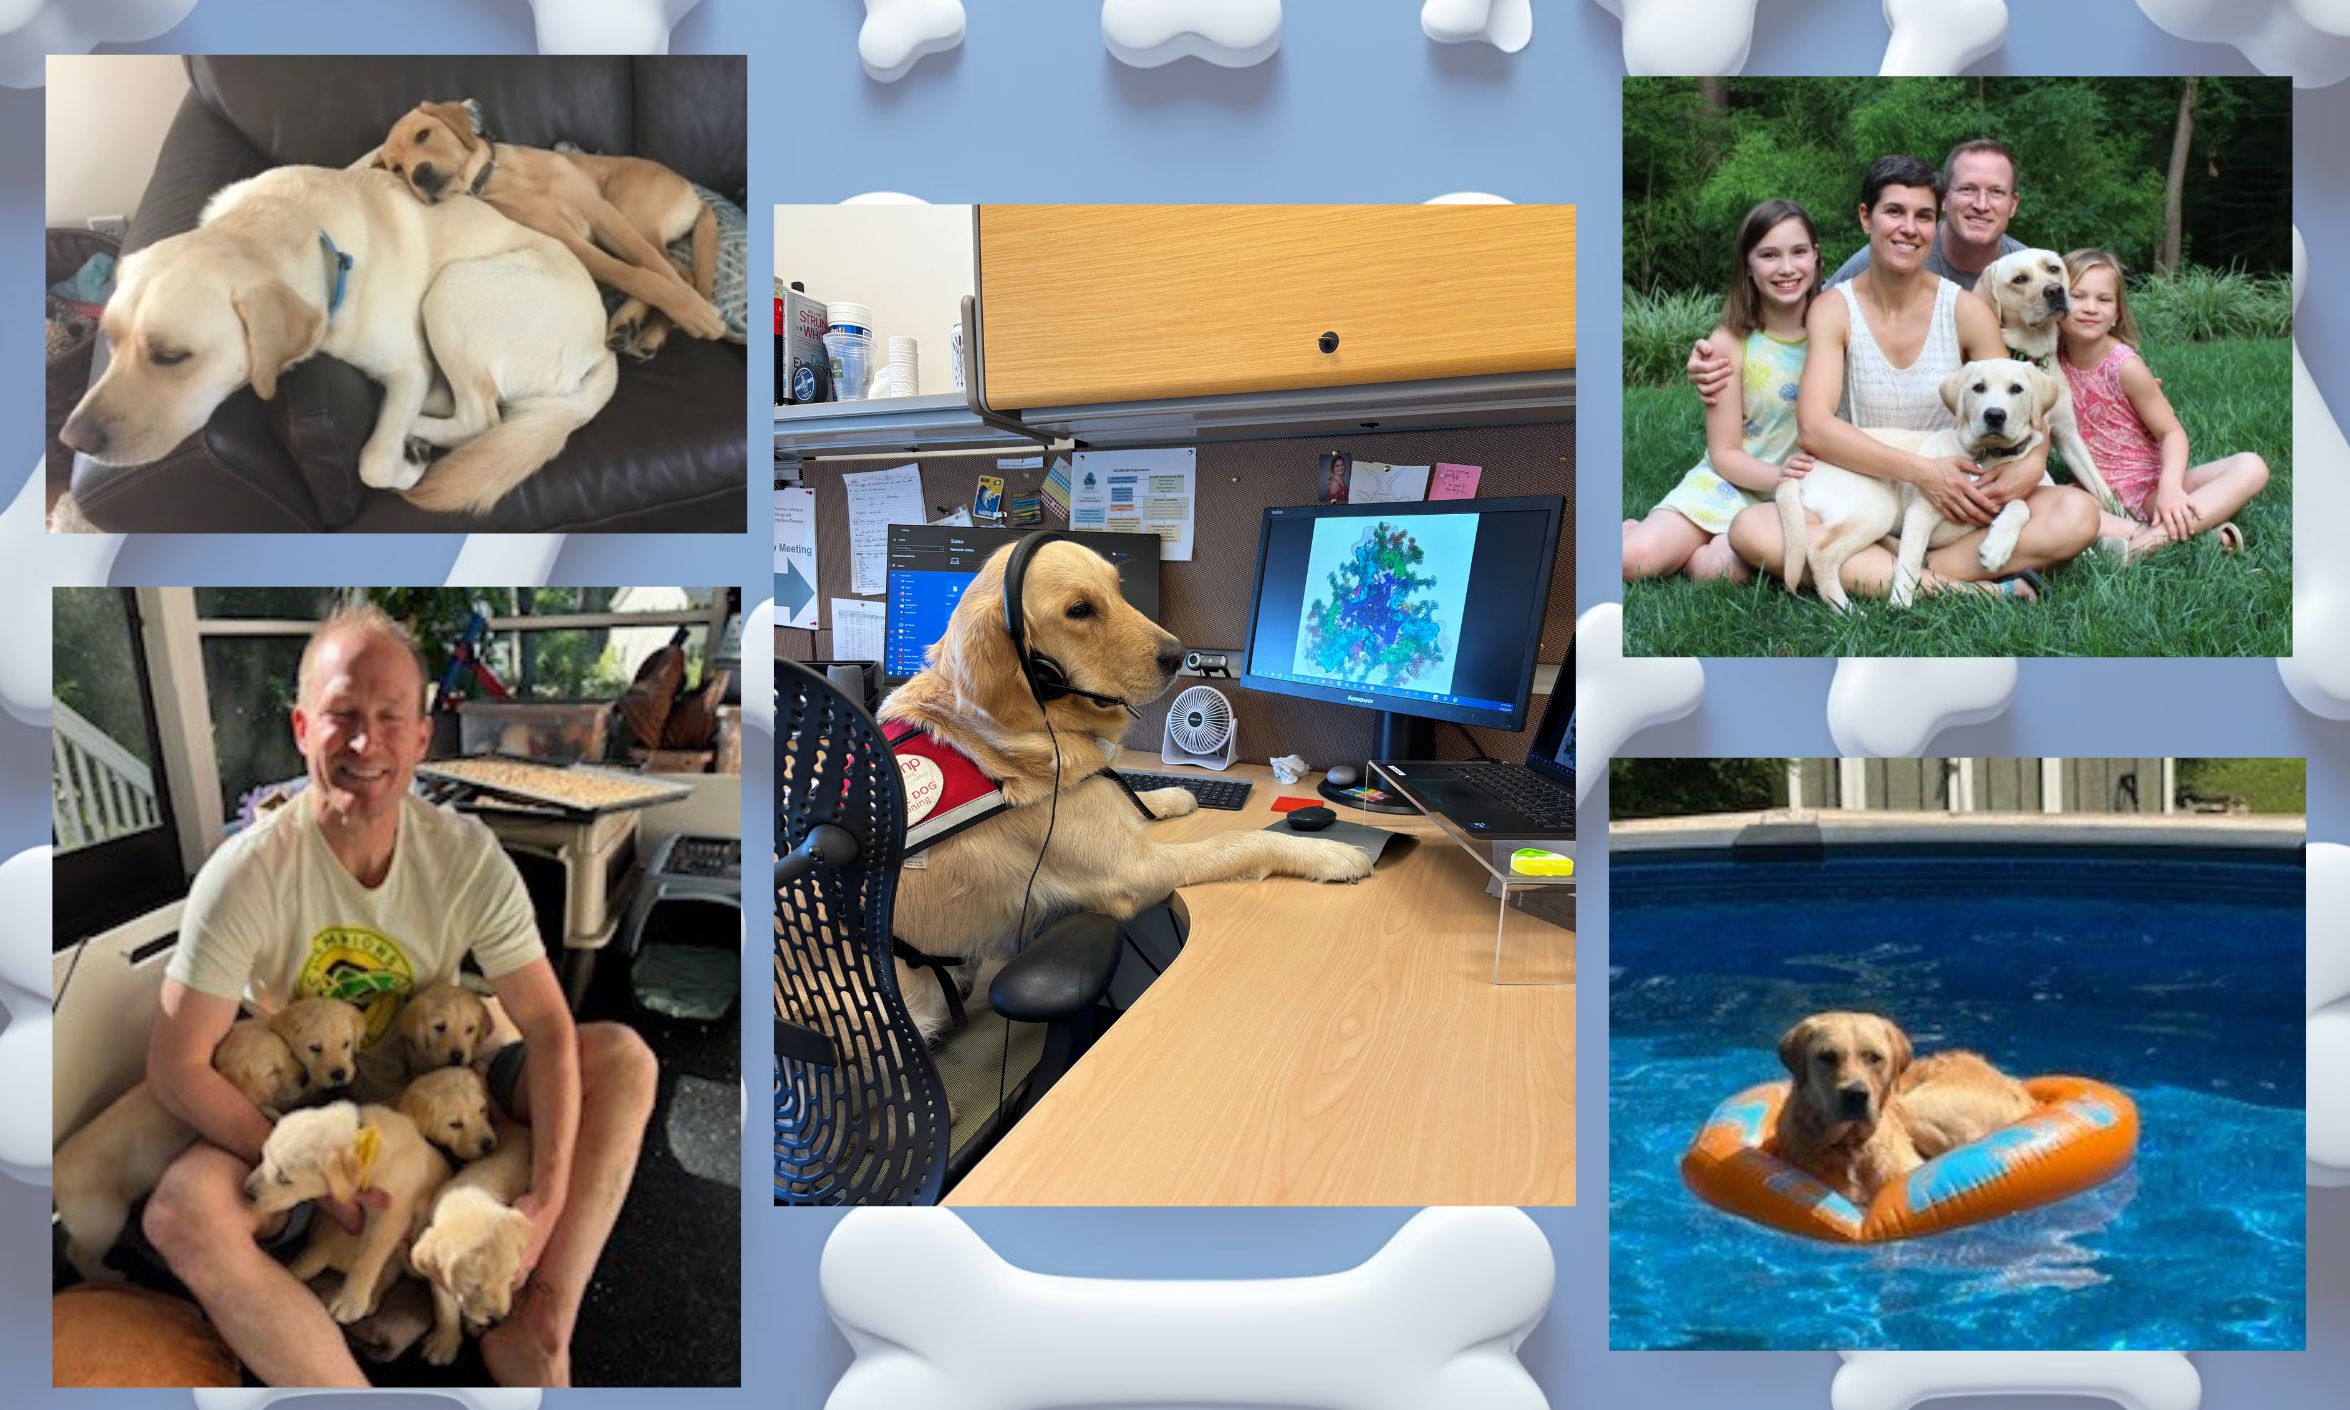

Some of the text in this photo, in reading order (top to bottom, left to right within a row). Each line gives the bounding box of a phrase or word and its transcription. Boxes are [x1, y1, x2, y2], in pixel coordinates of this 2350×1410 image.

[779, 542, 812, 557] Meeting
[1347, 694, 1374, 704] lenovo
[911, 781, 937, 799] DOG
